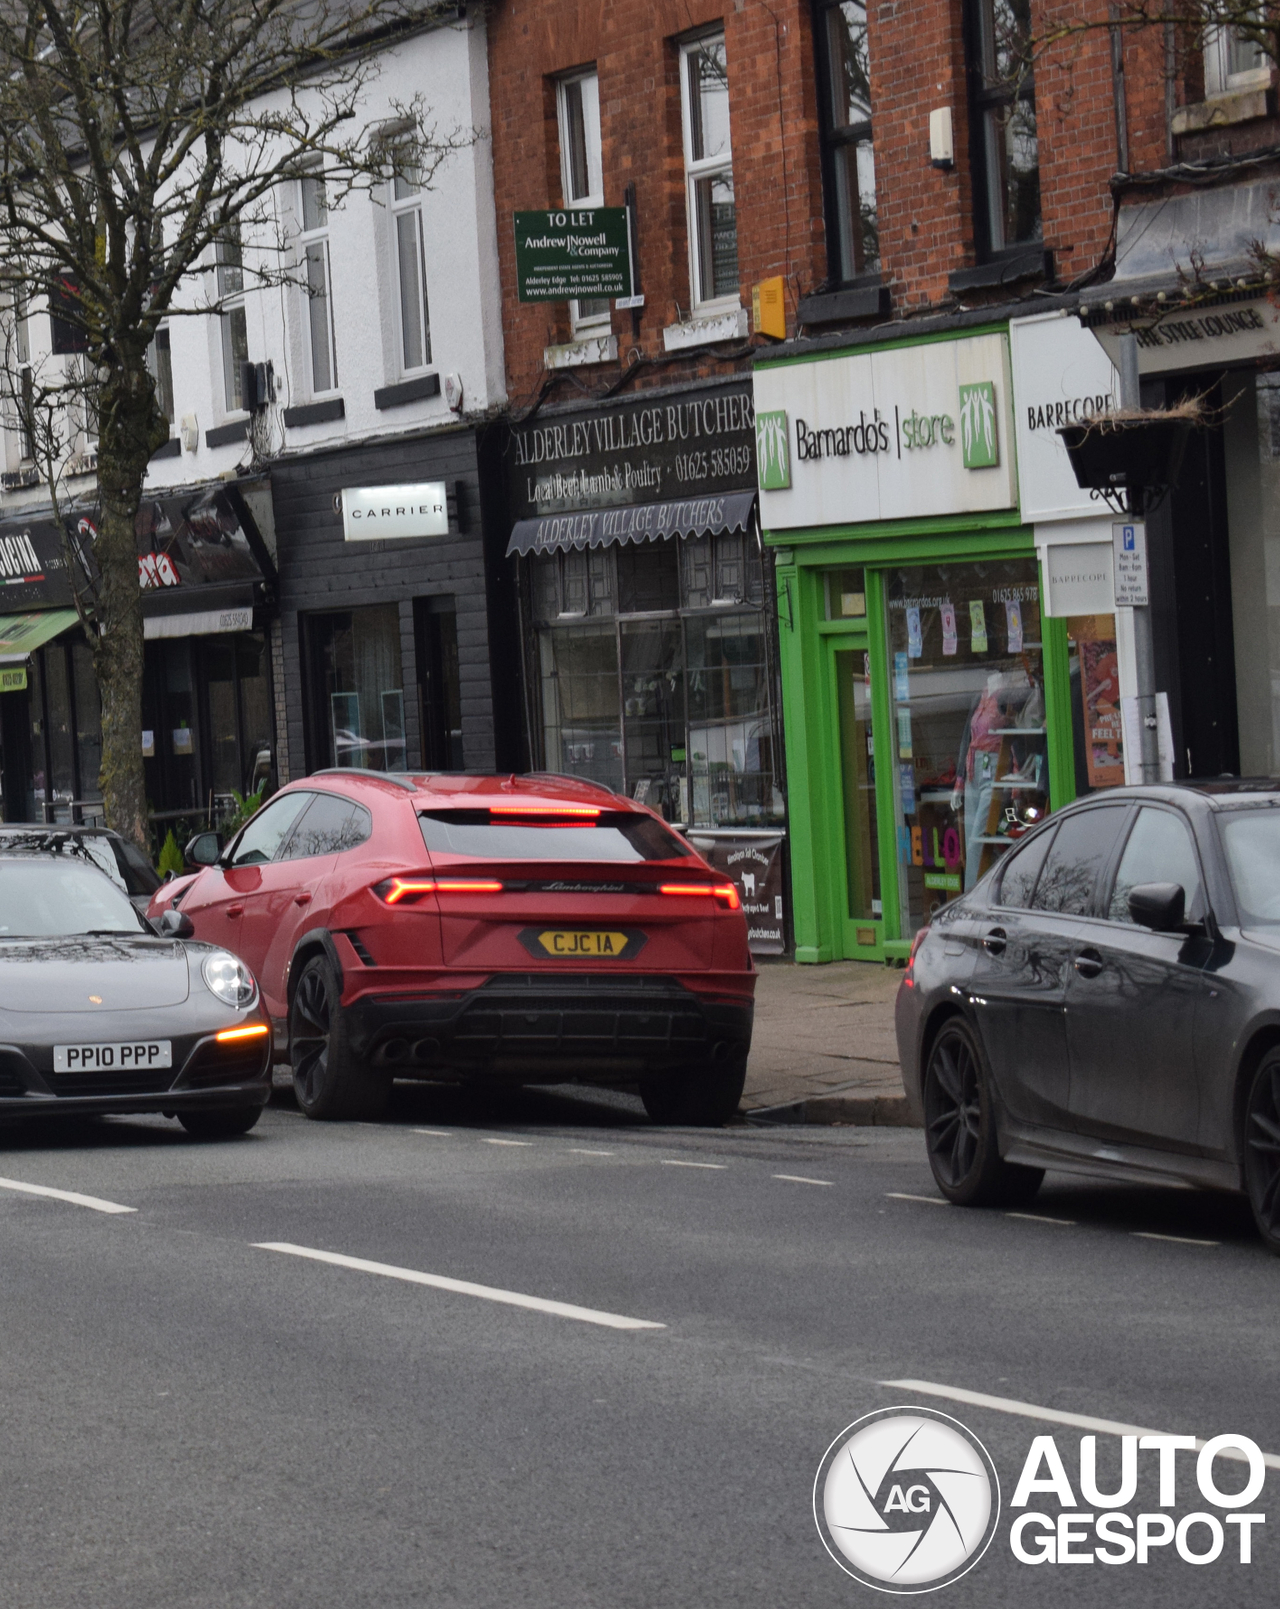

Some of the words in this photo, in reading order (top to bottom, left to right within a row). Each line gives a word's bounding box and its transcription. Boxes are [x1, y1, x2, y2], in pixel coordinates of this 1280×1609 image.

[547, 213, 566, 227] TO
[571, 212, 595, 226] LET
[525, 236, 566, 248] Andrew
[571, 233, 606, 246] Nowell
[578, 247, 620, 258] Company
[526, 277, 551, 286] Alderley
[552, 275, 567, 285] Edge
[570, 275, 581, 283] Tel:
[581, 274, 600, 283] 01625
[601, 273, 623, 282] 585905
[526, 282, 623, 296] www.andrewjnowell.co.uk
[1158, 320, 1203, 344] STYLE
[1197, 308, 1264, 337] LOUNGE
[515, 420, 593, 465] ALDERLEY
[592, 408, 663, 455] VILLAGE
[796, 407, 888, 460] Barnardo's
[902, 409, 955, 448] store
[527, 475, 554, 503] Local
[581, 465, 611, 494] Lamb
[612, 464, 623, 491] &
[624, 460, 661, 493] Poultry
[675, 451, 709, 482] 01625
[711, 445, 752, 478] 585059
[352, 504, 443, 519] CARRIER
[535, 514, 598, 544] ALDERLEY
[602, 506, 656, 535] VILLAGE
[658, 499, 725, 529] BUTCHERS
[992, 588, 1011, 602] 01625
[1135, 595, 1147, 603] hours
[1092, 728, 1114, 739] FEEL
[897, 826, 960, 868] HELLO
[542, 881, 624, 893] Lamborghini
[553, 934, 590, 952] CJC
[67, 1047, 114, 1067] PP10
[121, 1045, 159, 1065] PPP
